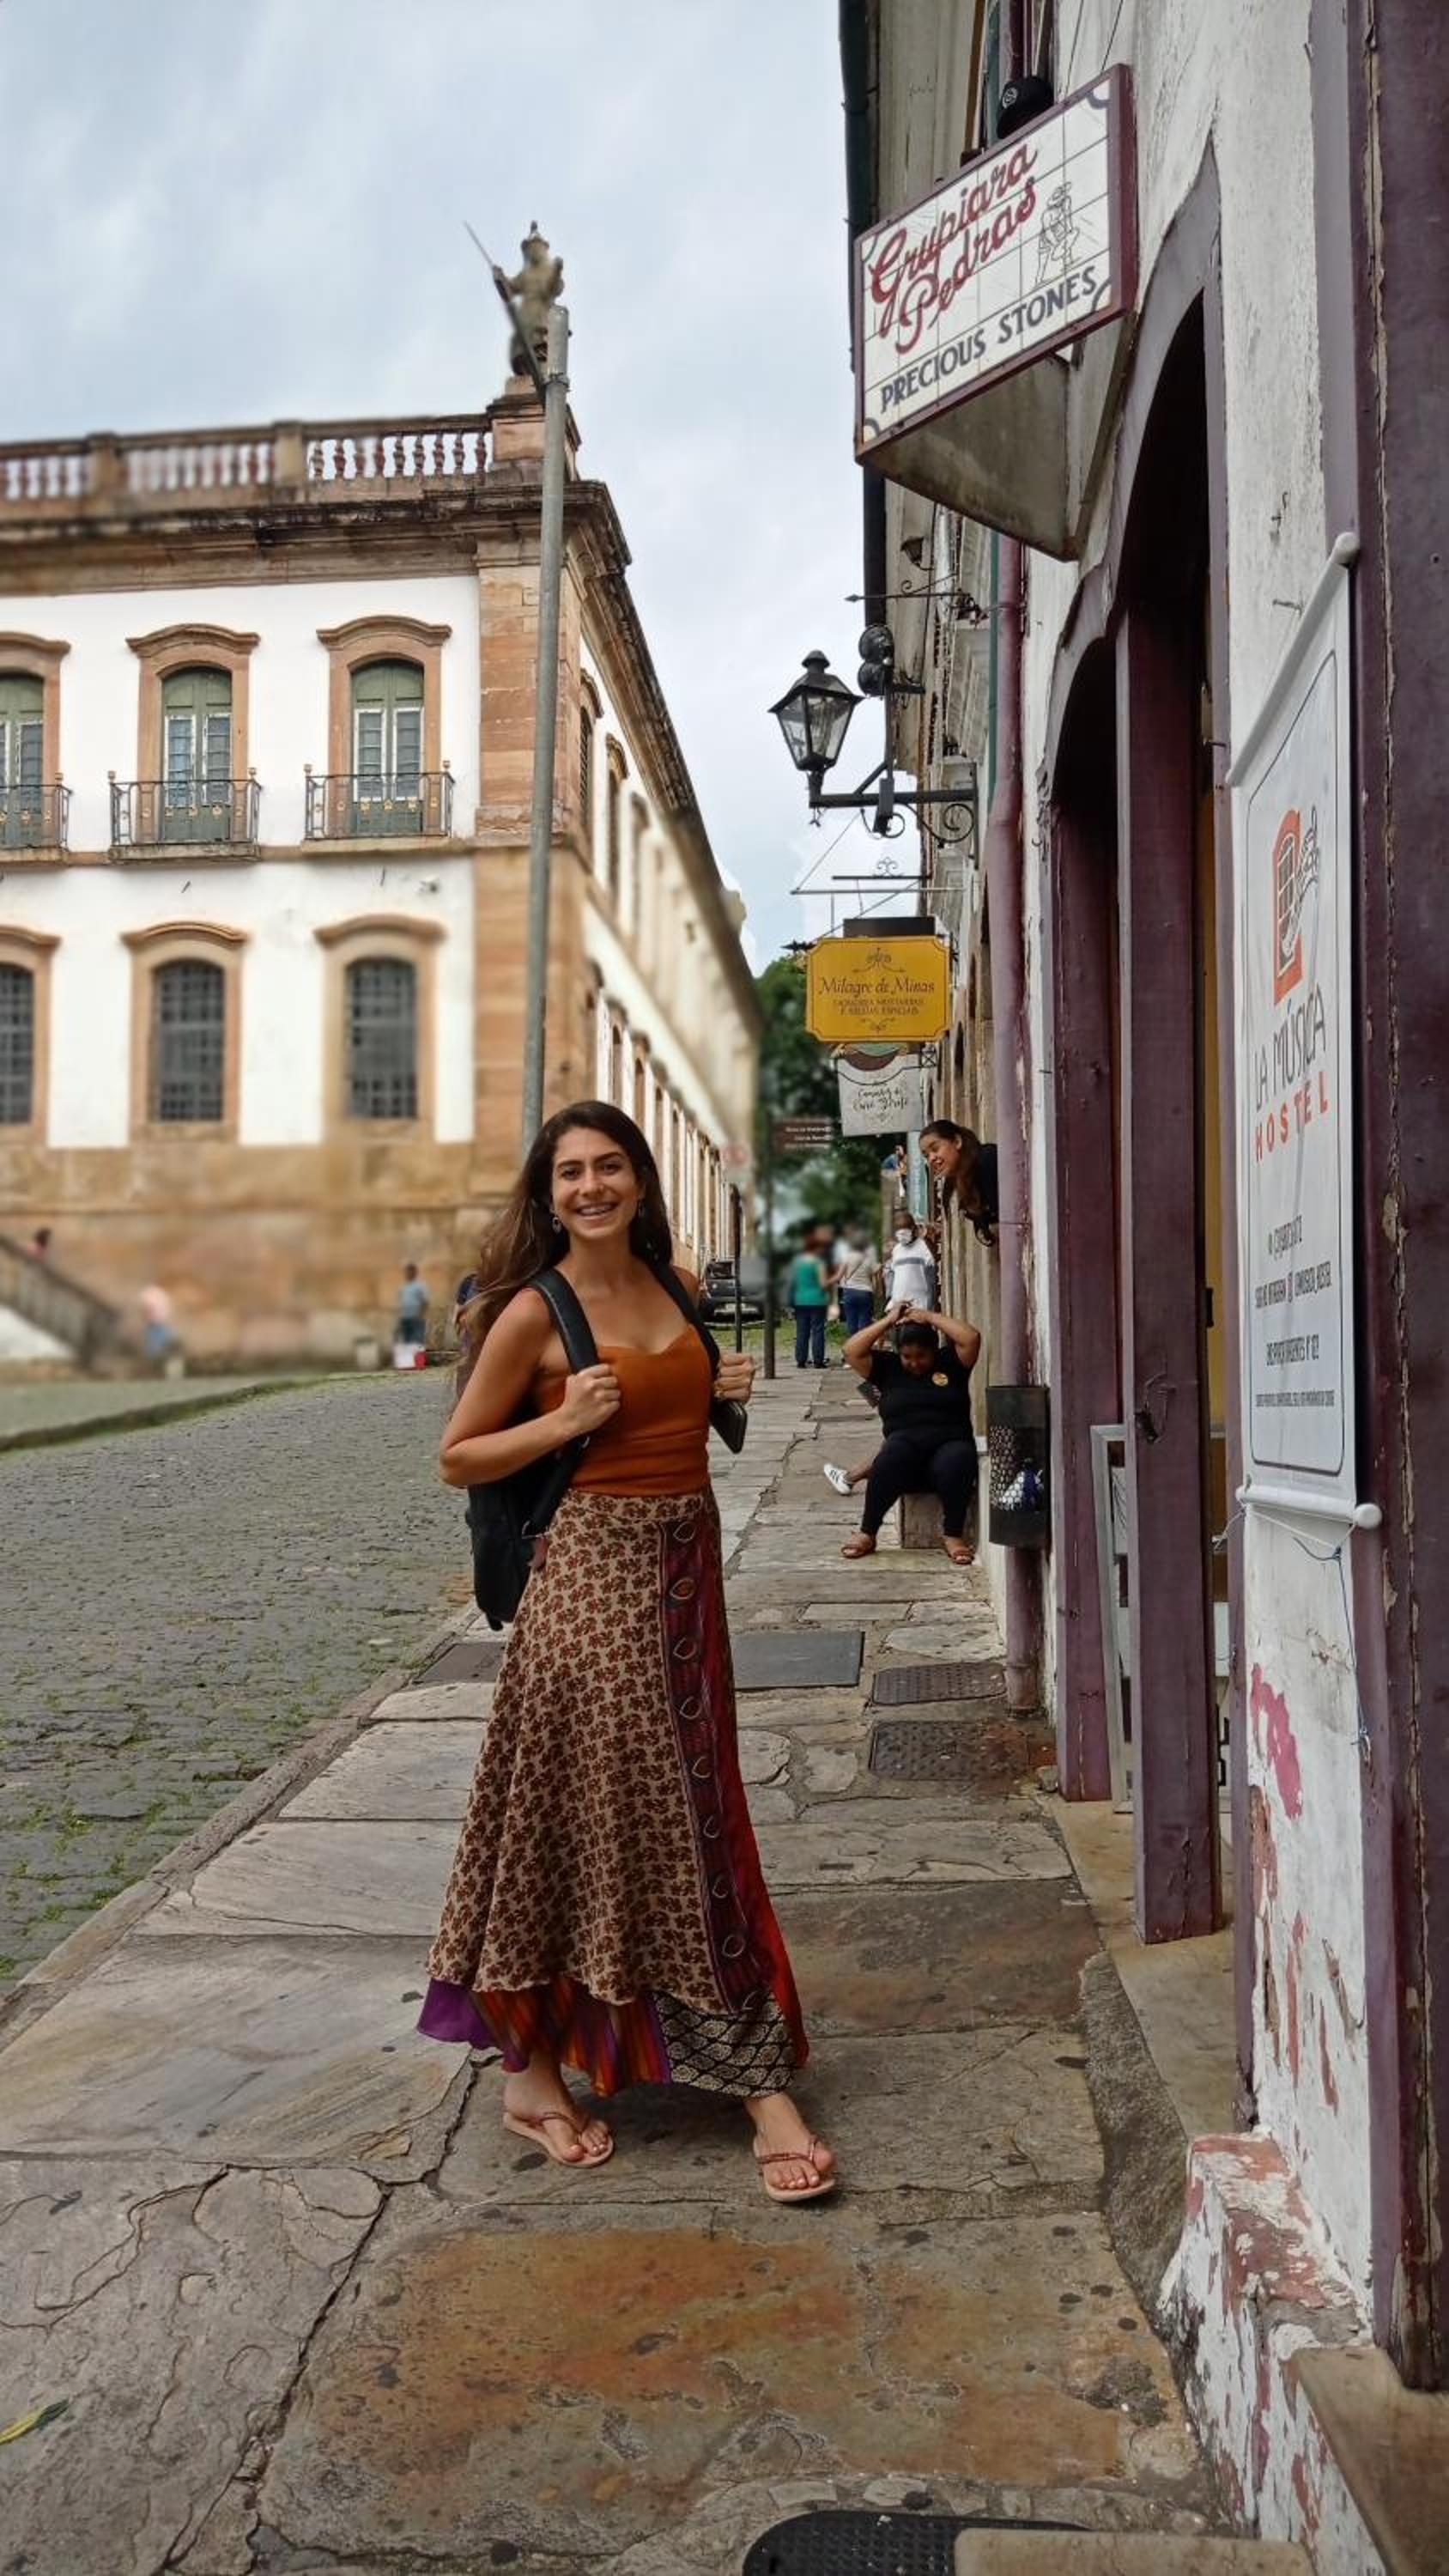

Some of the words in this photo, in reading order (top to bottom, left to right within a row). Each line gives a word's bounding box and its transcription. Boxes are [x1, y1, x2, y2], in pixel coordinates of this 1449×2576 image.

[869, 143, 1037, 338] Grupiara
[895, 175, 1037, 355] Pedras
[880, 328, 986, 414] PRECIOUS
[997, 265, 1097, 343] STONES
[818, 977, 872, 998] Milagre
[875, 977, 889, 994] de
[890, 977, 935, 995] Minas
[1254, 1044, 1269, 1111] LA
[1273, 981, 1326, 1096] MÚSICA
[1254, 1070, 1328, 1163] HOSTEL
